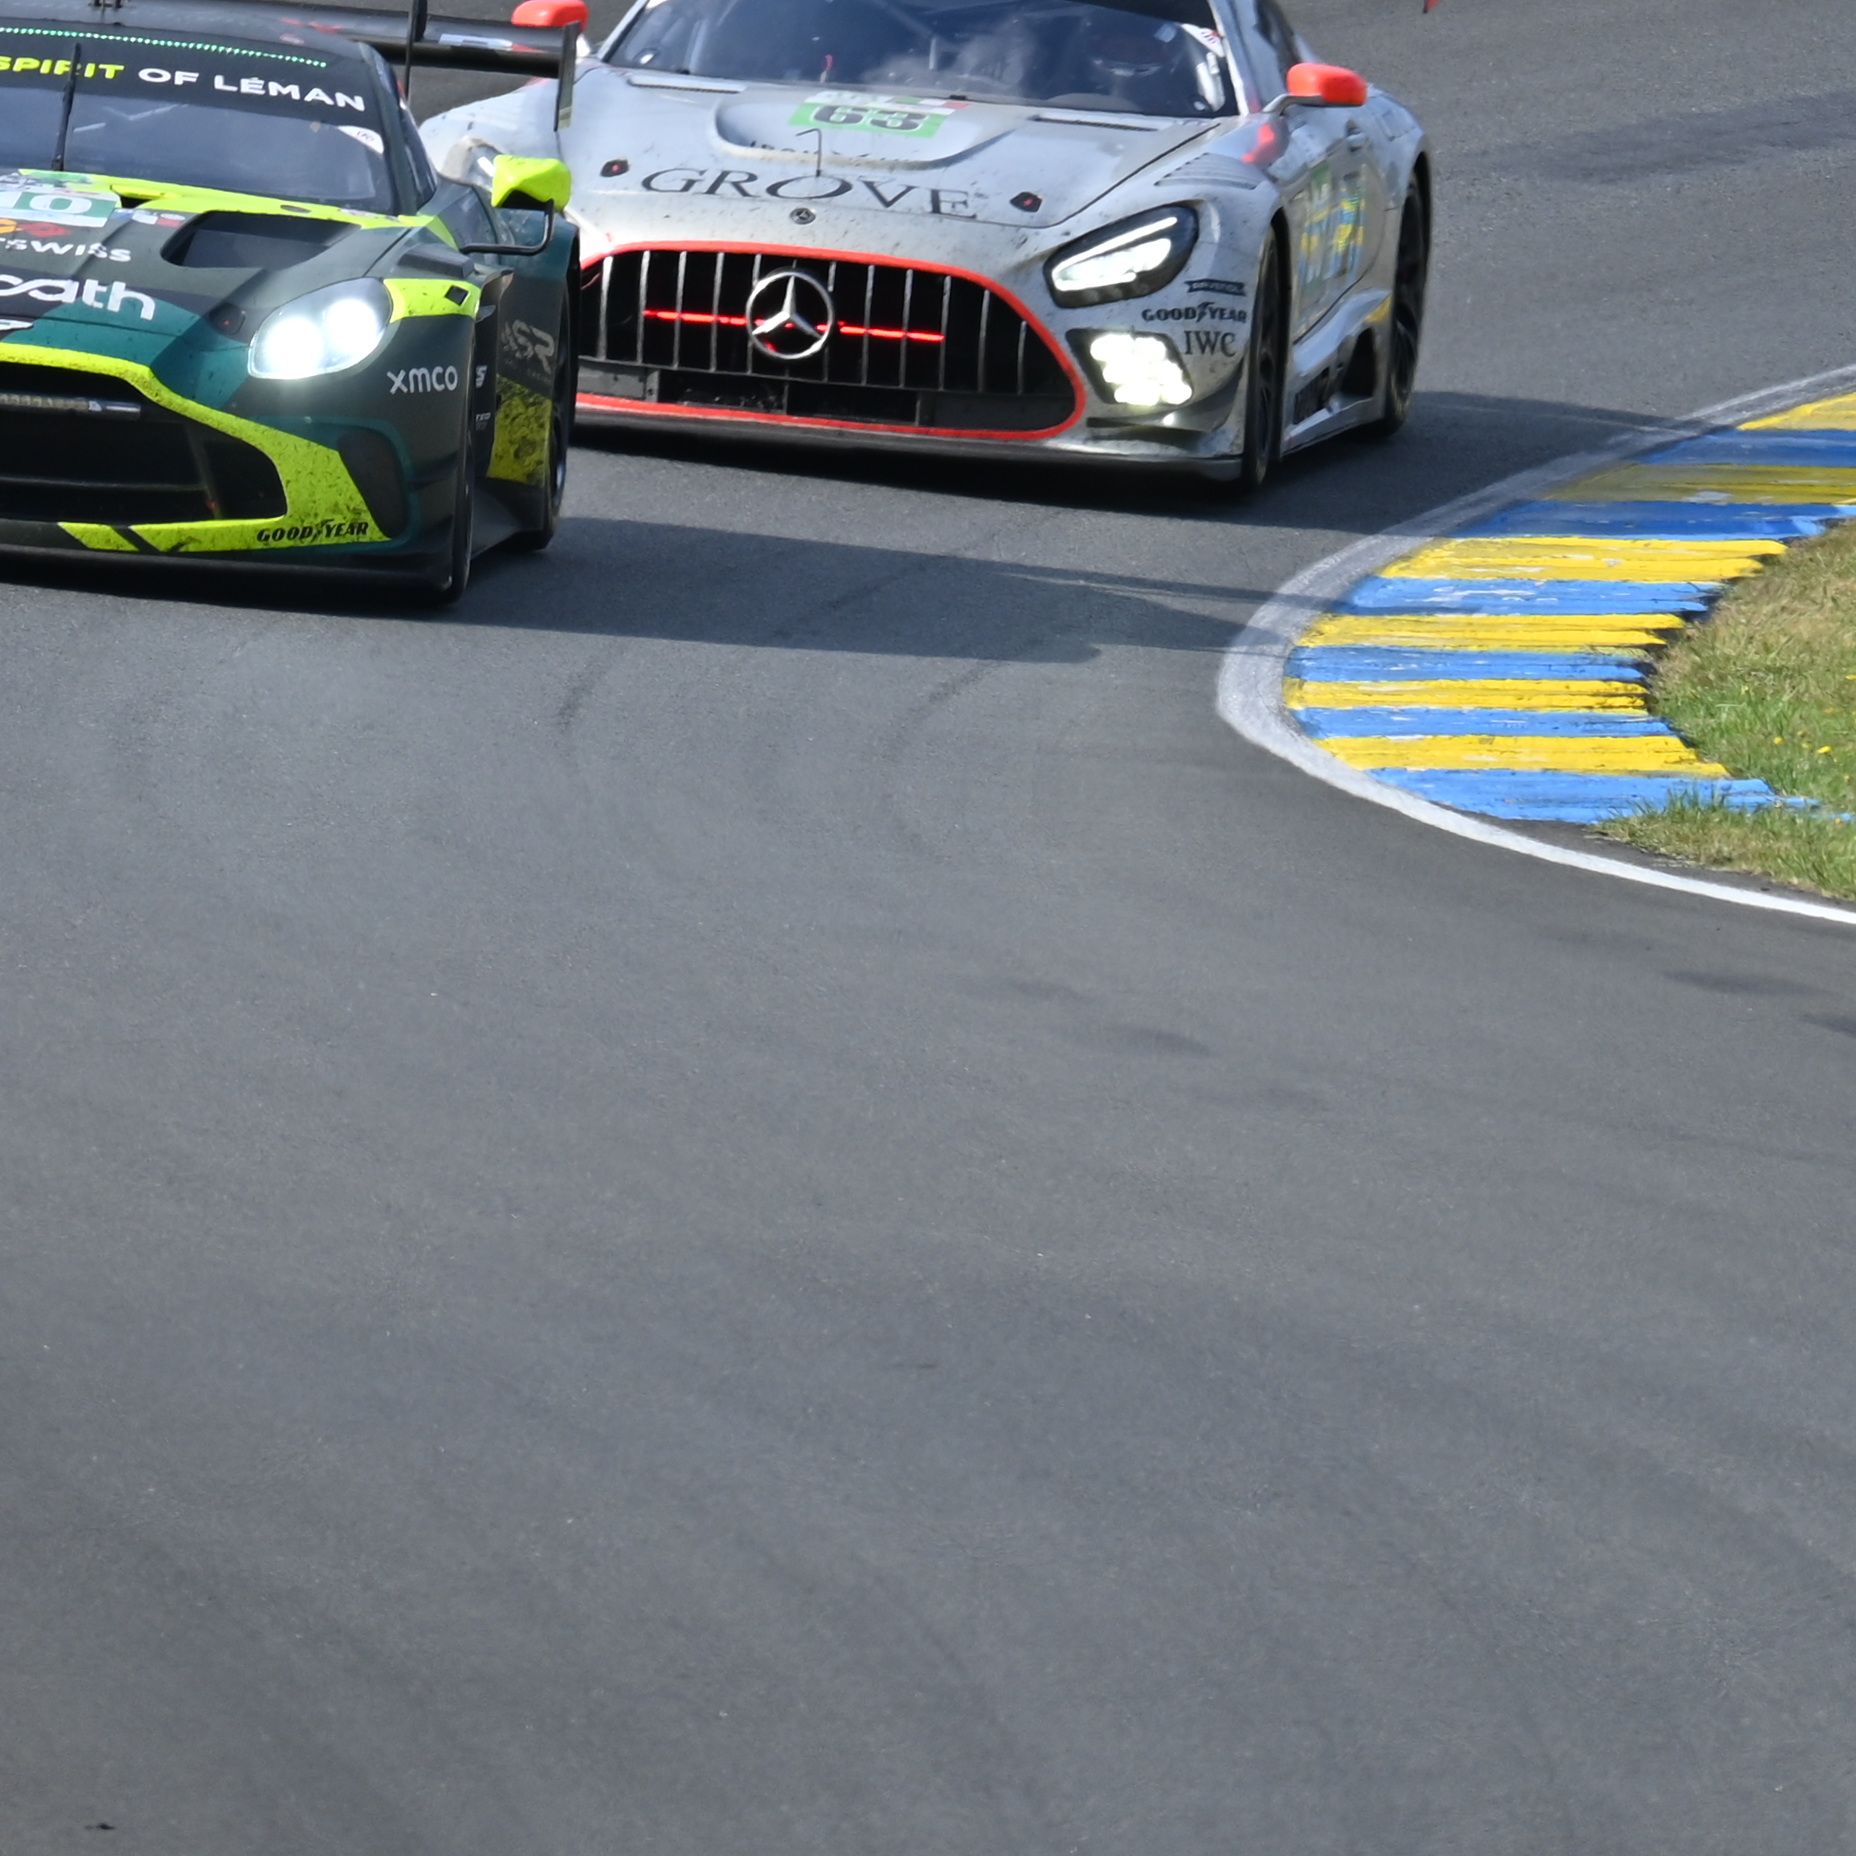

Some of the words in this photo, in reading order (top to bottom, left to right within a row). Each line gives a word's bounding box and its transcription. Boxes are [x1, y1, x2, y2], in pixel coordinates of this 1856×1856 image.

[138, 67, 200, 86] OF
[214, 74, 366, 112] LÉMAN
[812, 103, 929, 133] 63
[642, 167, 978, 221] GROVE
[1184, 330, 1237, 358] IWC
[386, 365, 459, 395] xmco
